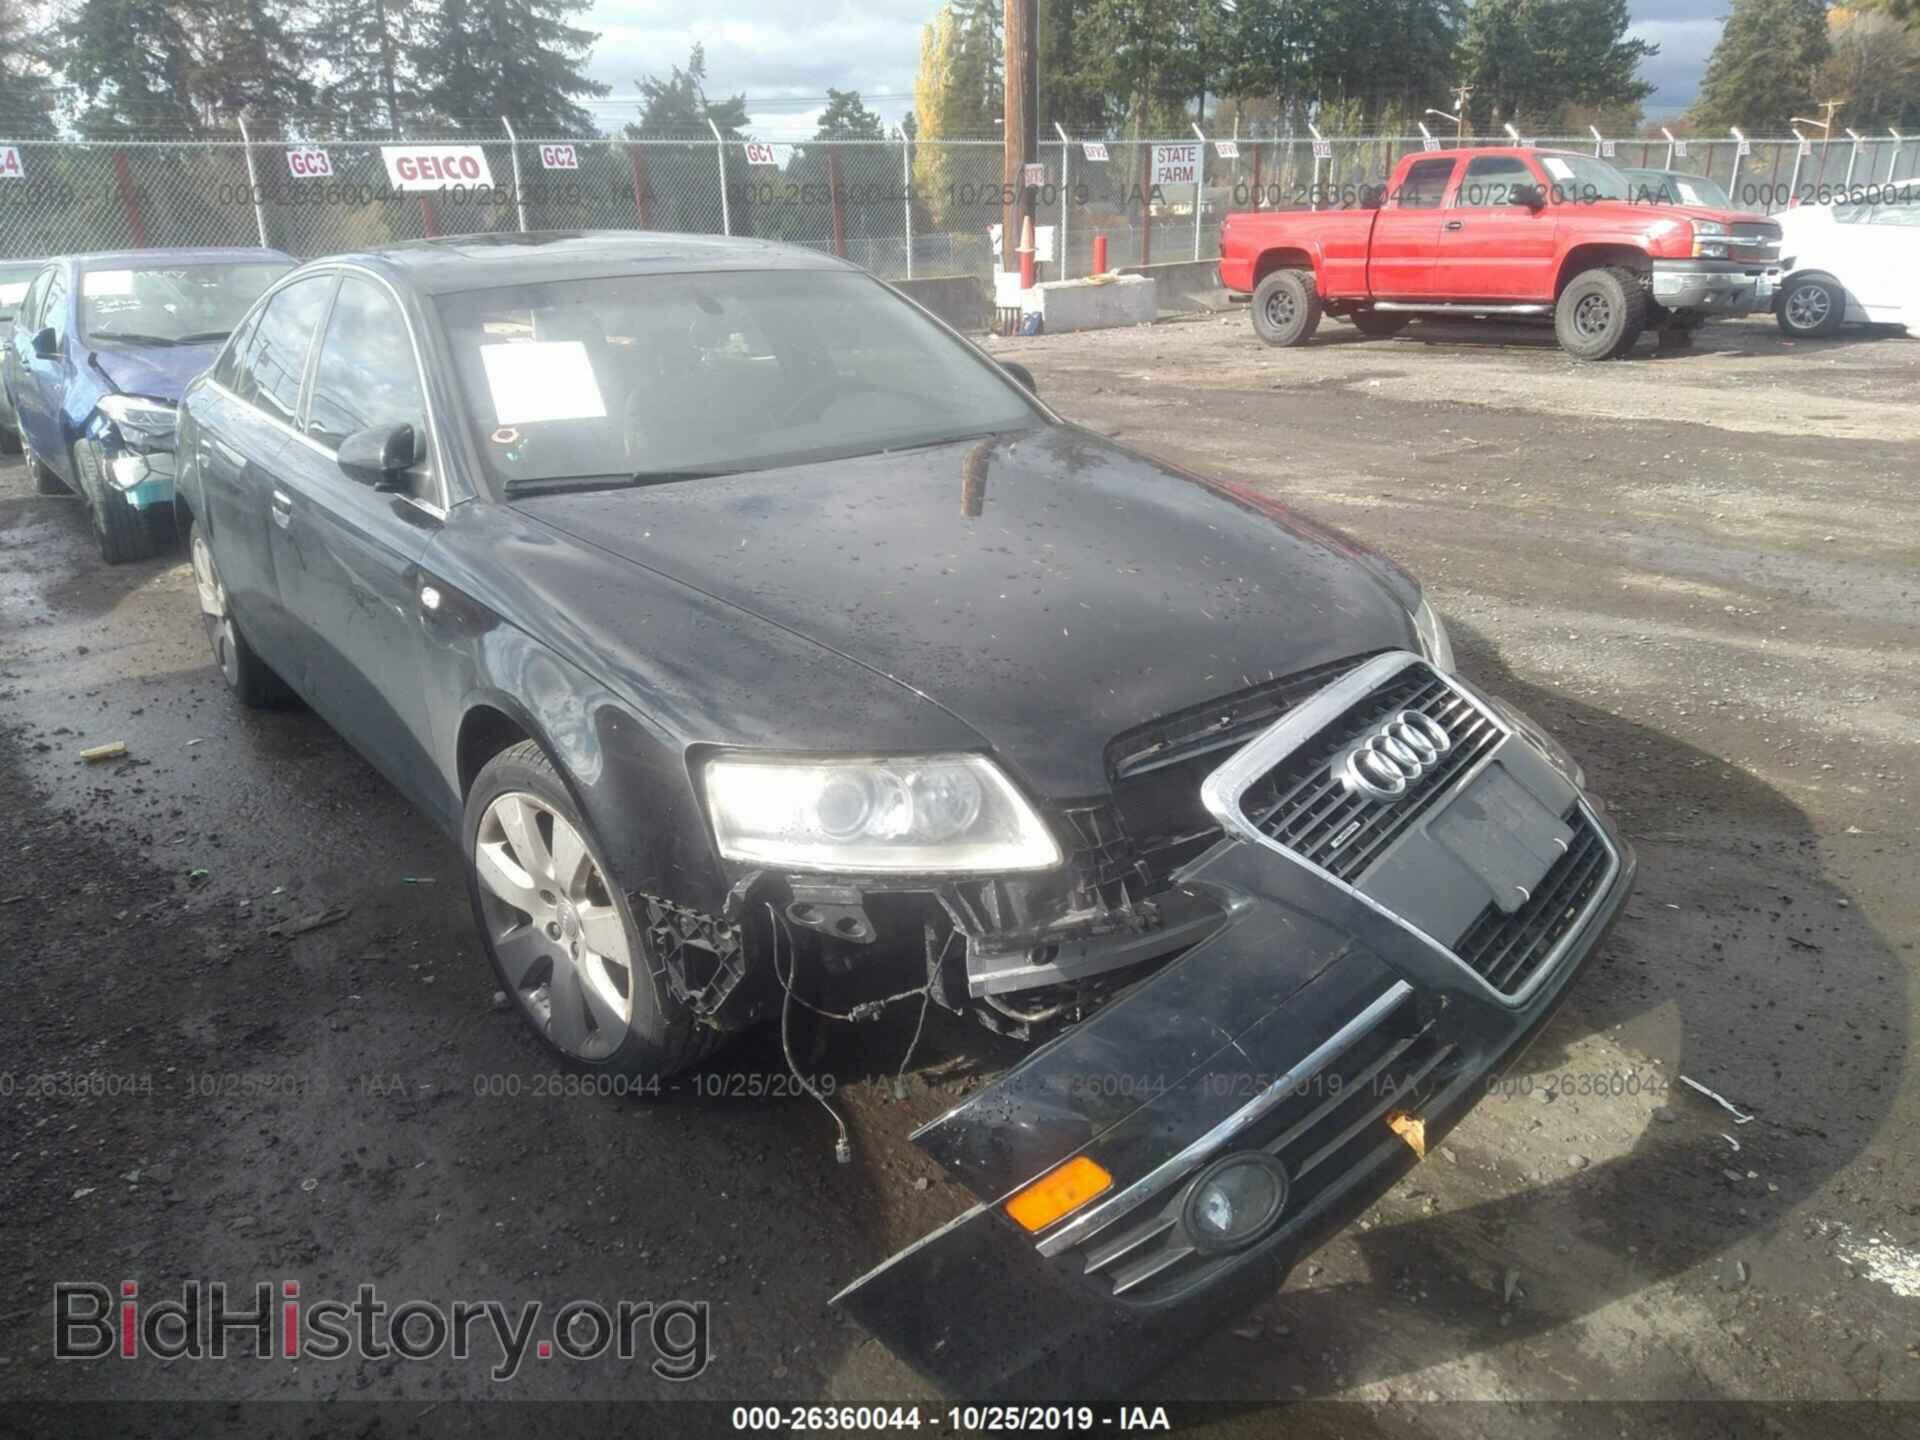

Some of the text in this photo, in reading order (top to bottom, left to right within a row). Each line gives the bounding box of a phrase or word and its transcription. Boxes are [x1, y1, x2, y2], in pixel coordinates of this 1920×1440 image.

[0, 149, 18, 174] 4
[543, 148, 575, 167] GC2
[747, 144, 775, 163] GC1
[1157, 146, 1196, 163] STATE
[292, 152, 330, 175] GC3
[396, 155, 481, 180] GEICO
[1158, 166, 1194, 182] FARM
